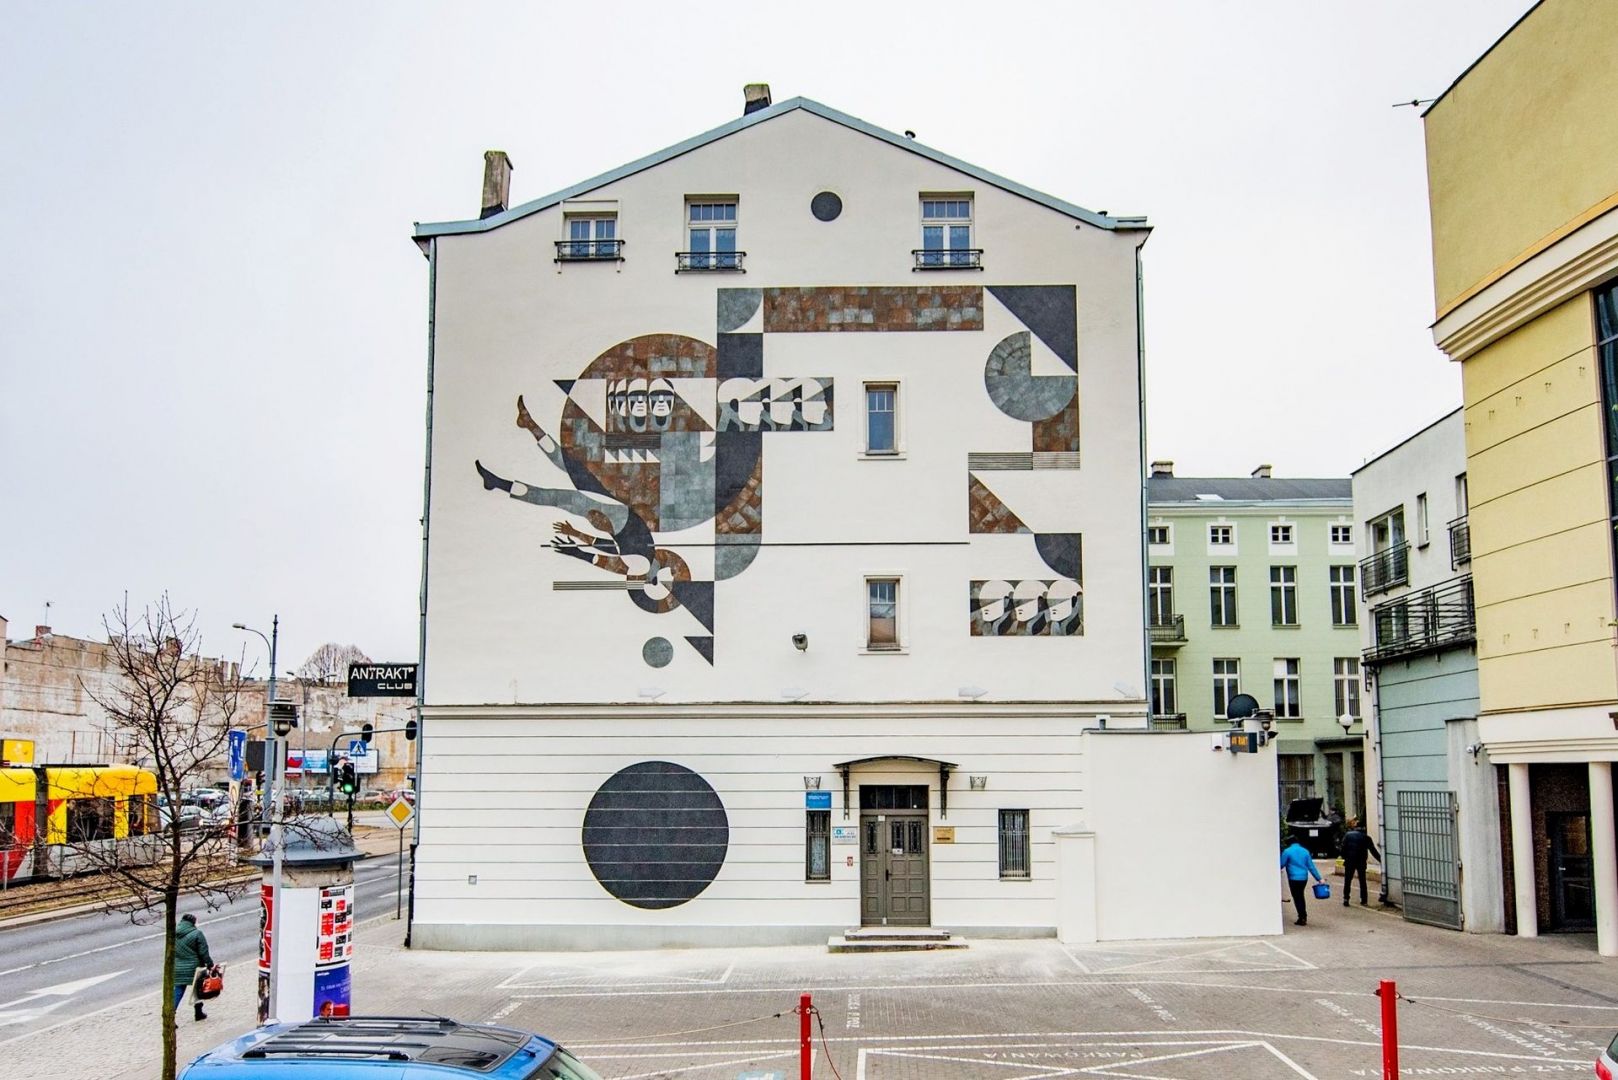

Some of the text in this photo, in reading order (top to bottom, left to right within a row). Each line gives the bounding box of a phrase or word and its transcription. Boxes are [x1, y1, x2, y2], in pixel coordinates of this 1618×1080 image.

[351, 666, 411, 680] ANTRAKT
[983, 1051, 1145, 1059] PARKOWANIA
[1348, 1065, 1527, 1077] PARKOWAIA
